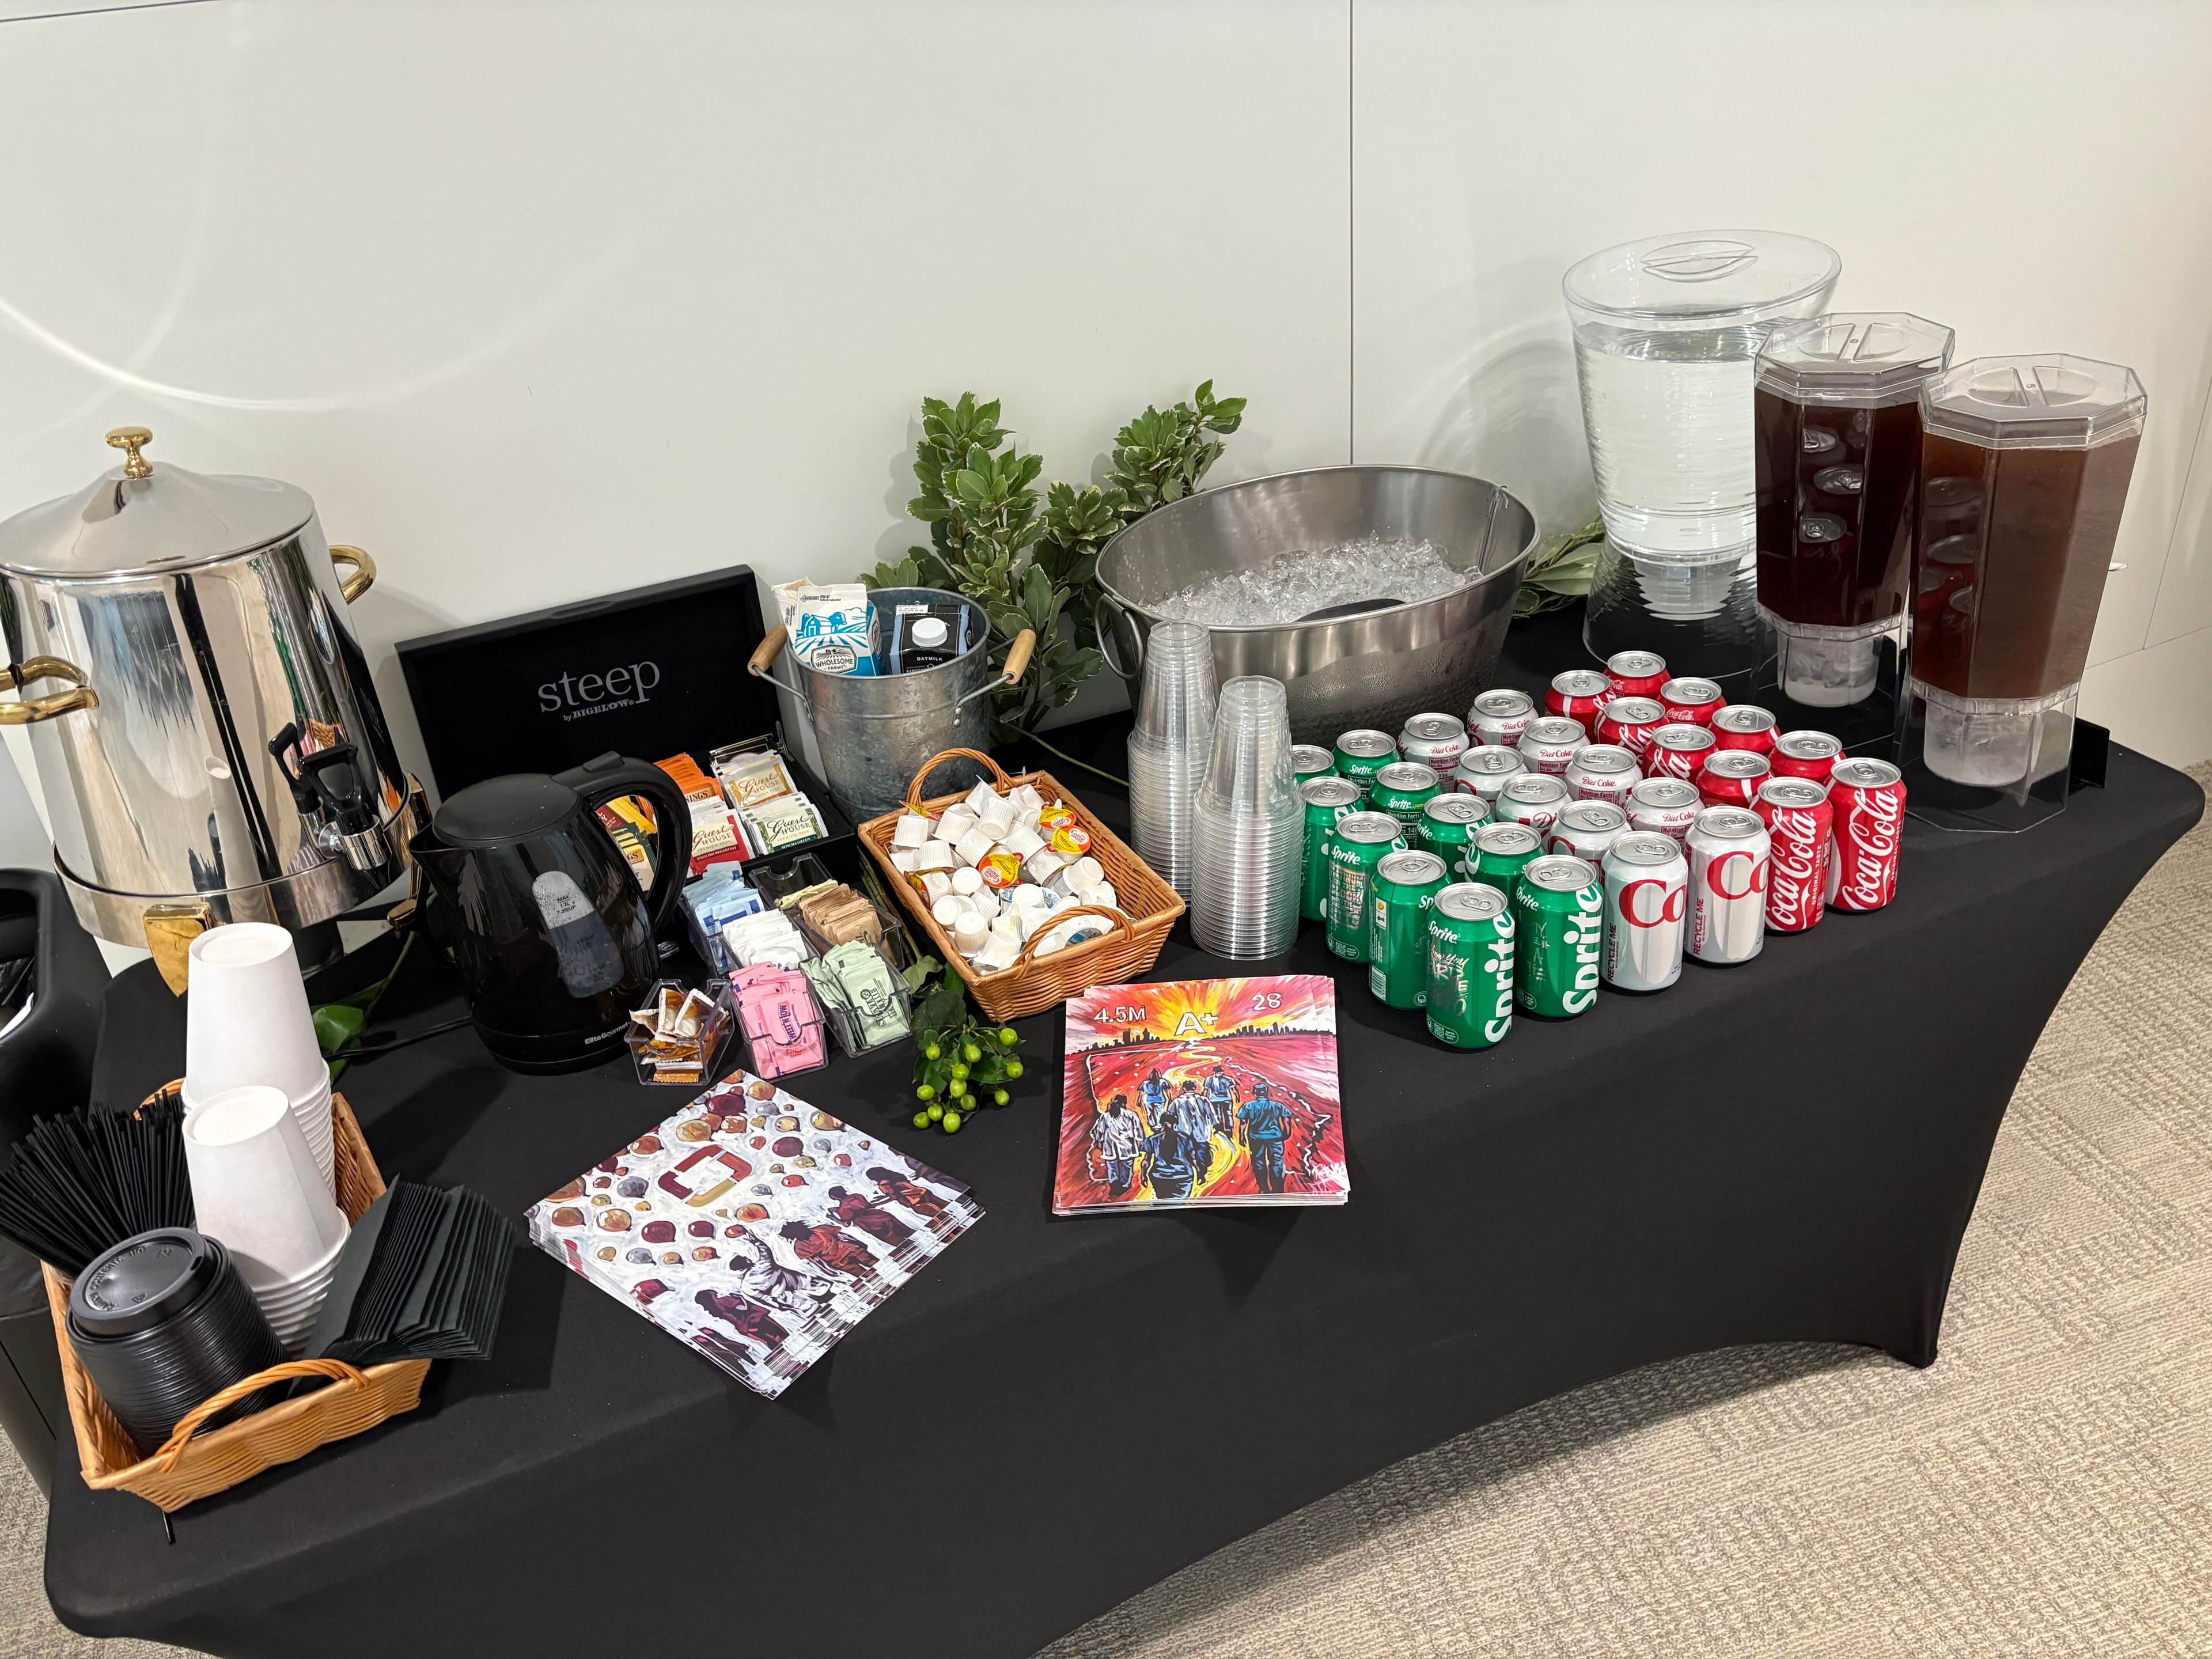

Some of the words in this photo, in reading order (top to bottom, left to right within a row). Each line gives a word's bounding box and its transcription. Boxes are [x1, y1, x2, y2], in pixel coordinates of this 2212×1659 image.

[815, 658, 853, 668] WHOLESOME
[538, 661, 660, 713] steep
[572, 699, 630, 719] BIGELOW
[1502, 722, 1517, 730] Diet
[1430, 746, 1445, 754] Diet
[1445, 744, 1460, 753] Coke
[1540, 749, 1555, 757] Diet
[1350, 764, 1372, 774] Sprite
[738, 772, 781, 804] Guest
[753, 780, 780, 794] HOUSE
[1582, 777, 1597, 786] Diet
[1597, 779, 1615, 787] Coke
[1388, 798, 1412, 809] Sprite
[1662, 813, 1679, 822] Diet
[1679, 812, 1695, 821] Coke
[767, 814, 814, 843] Guest
[782, 823, 811, 835] HOUSE
[1071, 830, 1085, 841] Coffee
[692, 824, 734, 851] Guest
[702, 832, 733, 846] HOUSE
[777, 833, 797, 842] PREMIUM
[1059, 835, 1074, 849] HAZELNUT
[1071, 835, 1083, 843] mate
[697, 853, 714, 861] ENGLISH
[715, 846, 737, 855] BREAKFAST
[698, 844, 718, 852] PREMIUM
[1331, 845, 1361, 865] Sprite
[1842, 788, 1899, 910] Coca-Cola
[987, 868, 999, 877] mate
[997, 859, 1012, 875] HAZELNUT
[1764, 806, 1817, 931] Coca-Cola
[985, 870, 999, 882] Coffee
[1707, 851, 1770, 900] Co
[1516, 886, 1539, 911] Sprite
[1619, 879, 1687, 928] Co
[1696, 897, 1704, 914] ME
[1428, 920, 1459, 944] Sprite
[1609, 923, 1616, 939] ME
[1694, 914, 1703, 955] RECYCLE
[1562, 884, 1603, 1014] Sprite
[1607, 940, 1616, 981] RECYCLE
[1484, 910, 1516, 1043] Sprite
[1251, 992, 1282, 1011] 28
[1093, 1005, 1146, 1024] 4.5M
[1174, 1012, 1218, 1036] A+
